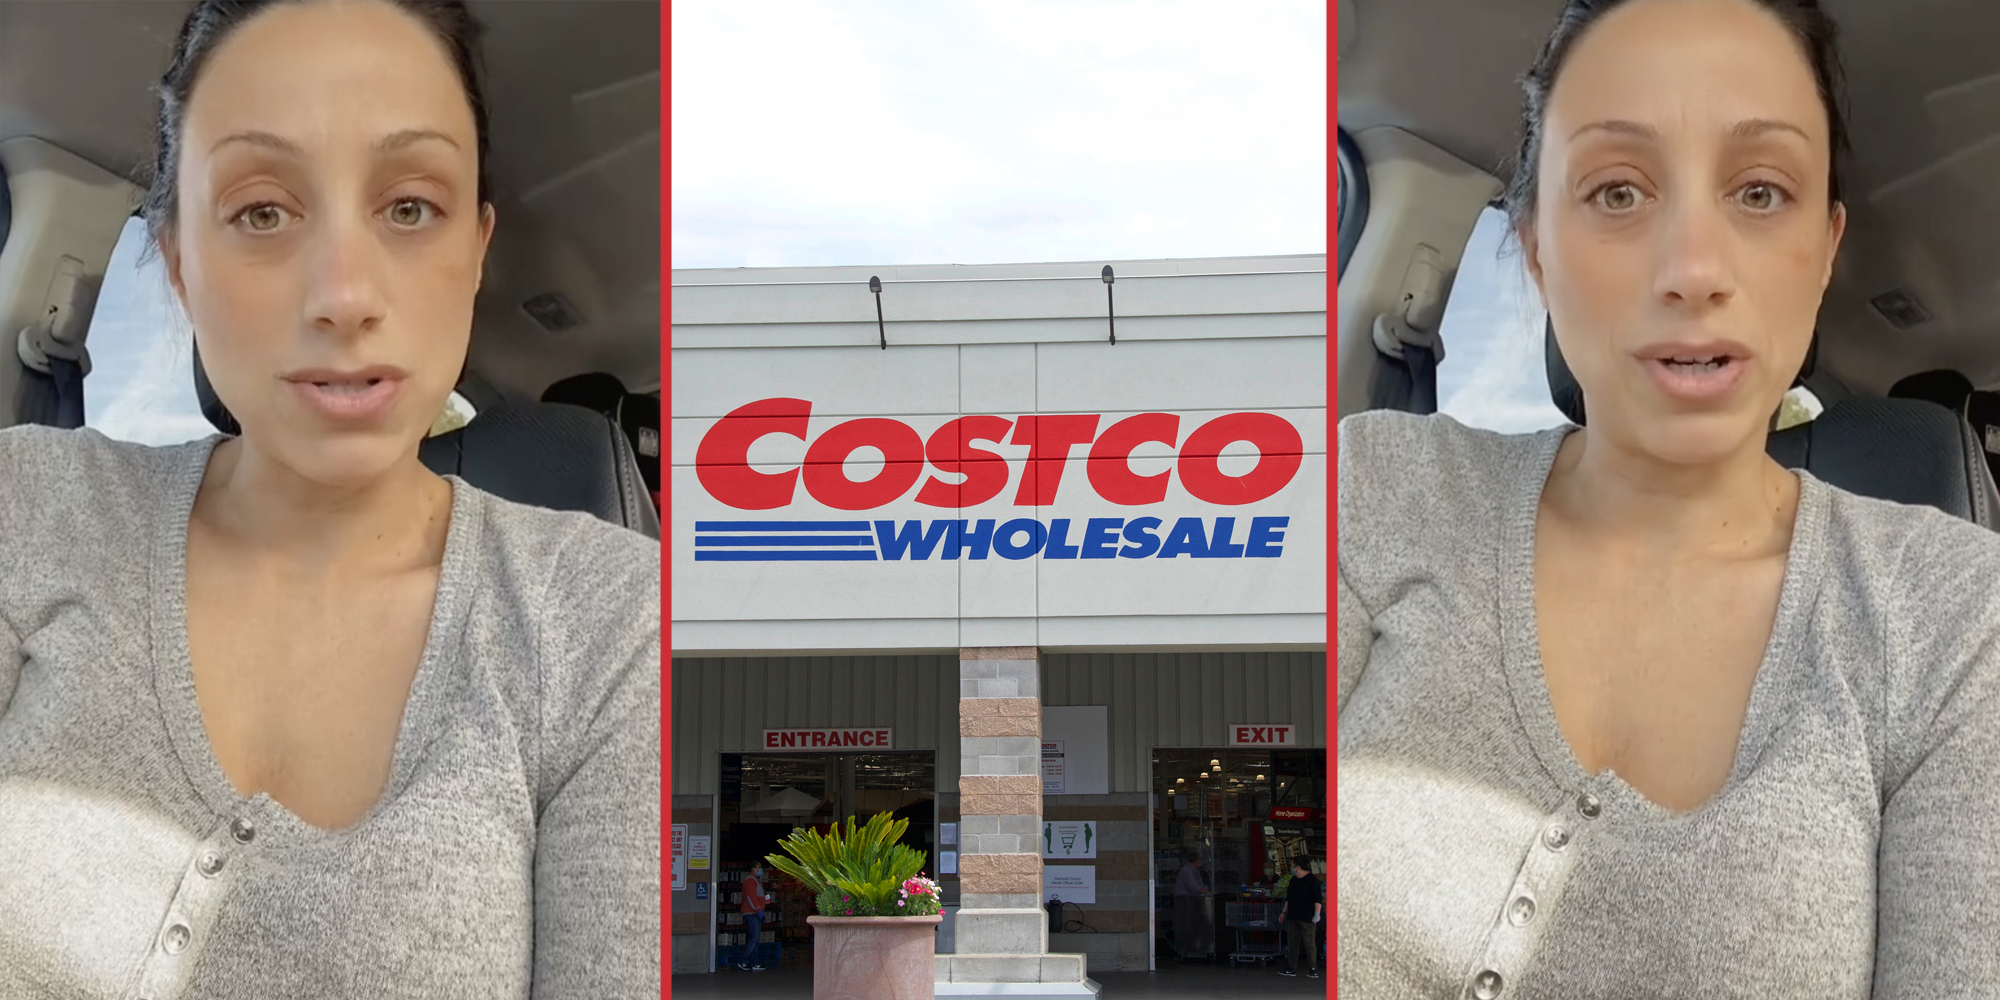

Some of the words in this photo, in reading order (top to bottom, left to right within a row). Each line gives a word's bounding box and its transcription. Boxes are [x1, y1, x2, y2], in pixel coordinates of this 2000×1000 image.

[874, 516, 1290, 560] WHOLESALE
[766, 730, 889, 748] ENTRANCE
[1236, 727, 1289, 743] EXIT
